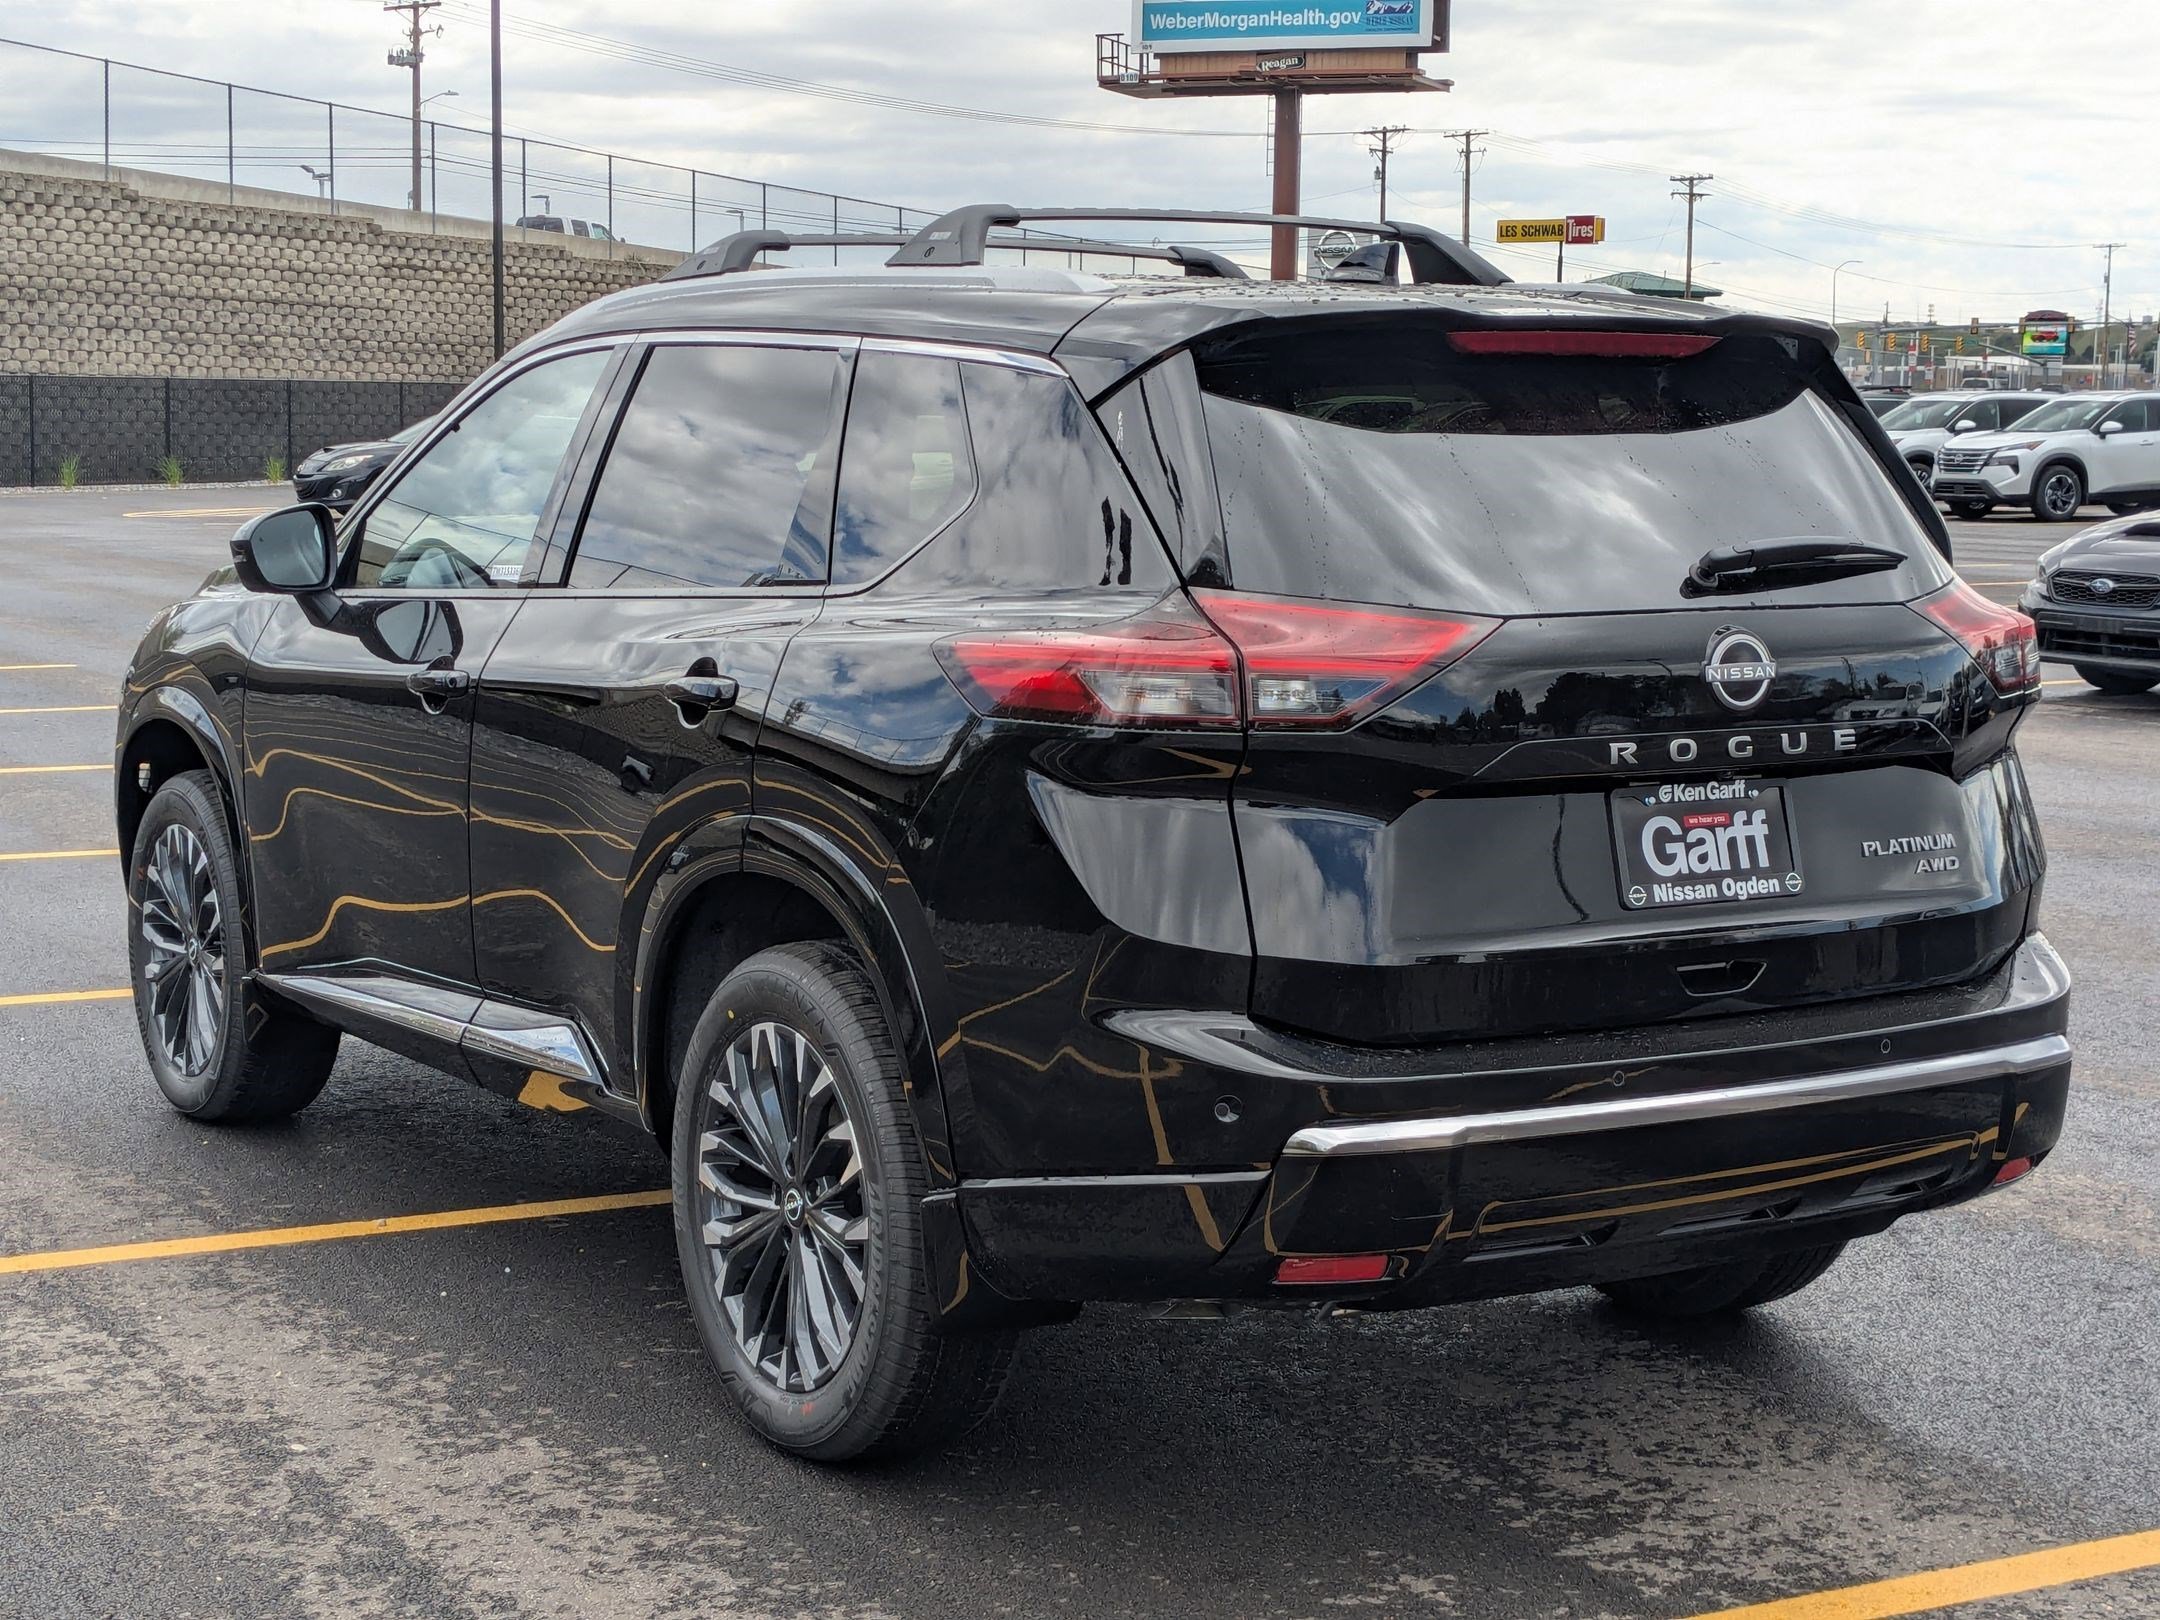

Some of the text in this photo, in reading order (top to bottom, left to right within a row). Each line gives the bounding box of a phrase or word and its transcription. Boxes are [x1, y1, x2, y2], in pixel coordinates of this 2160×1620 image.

[1150, 10, 1362, 31] WeberMorganHealth.gov
[1261, 57, 1299, 71] Reagan
[1500, 219, 1594, 241] LES SCHWAB Tires
[1708, 666, 1776, 680] NISSAN
[1609, 729, 1858, 765] ROGUE
[1673, 783, 1706, 802] Ken
[1706, 780, 1746, 800] Garff
[1641, 809, 1770, 877] Garff
[1861, 833, 1957, 857] PLATINUM
[1914, 855, 1960, 874] AWD
[1653, 876, 1781, 903] Nissan Ogden
